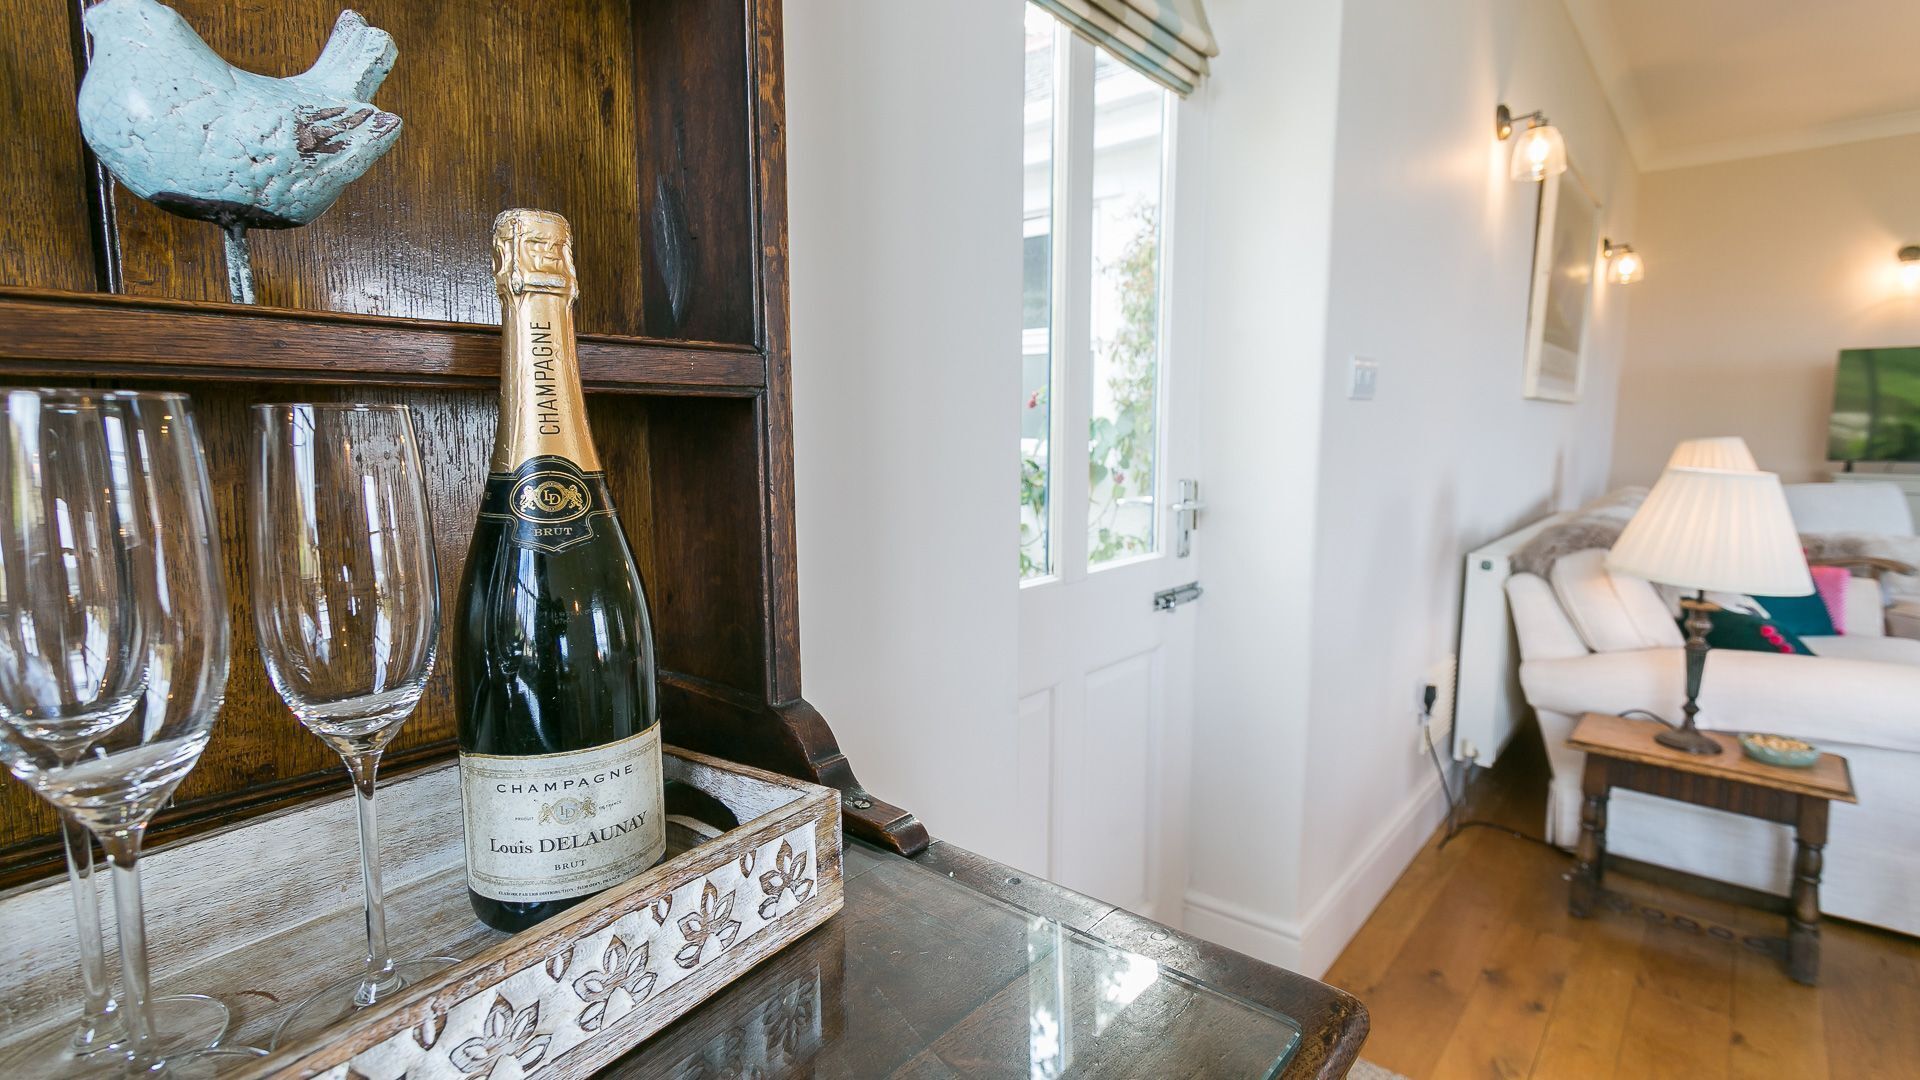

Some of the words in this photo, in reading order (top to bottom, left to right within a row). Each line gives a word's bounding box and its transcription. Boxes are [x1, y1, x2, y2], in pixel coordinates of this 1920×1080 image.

[529, 321, 561, 435] CHAMPAGNE
[533, 527, 573, 537] BRUT
[496, 764, 634, 794] CHAMPAGNE
[490, 838, 533, 855] Louis
[539, 810, 648, 854] DELAUNAY
[554, 858, 587, 871] BRUT
